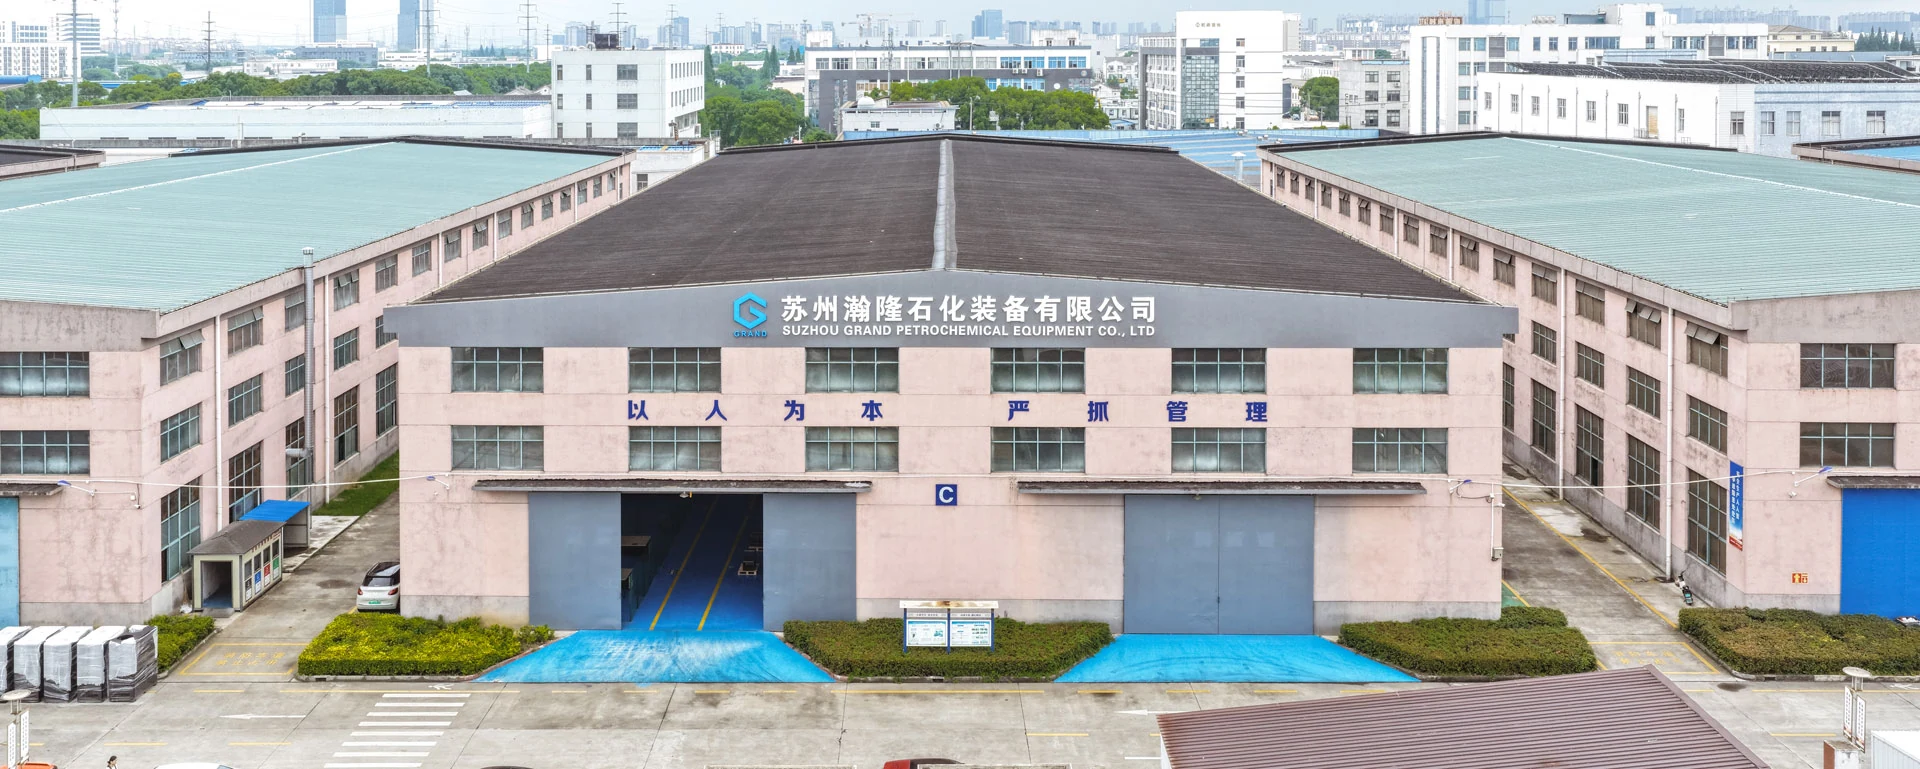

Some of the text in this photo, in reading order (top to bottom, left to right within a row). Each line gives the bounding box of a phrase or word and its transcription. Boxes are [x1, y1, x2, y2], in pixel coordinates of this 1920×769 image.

[781, 295, 1155, 323] 苏州瀚隆石化装备有限公司
[733, 330, 768, 338] GRAND
[782, 325, 1155, 337] SUZHOU GRAND PETROCHEMICAL EQUIPMENT CO., LTD
[627, 399, 1267, 422] 以人为本 严抓管理
[938, 486, 954, 503] C
